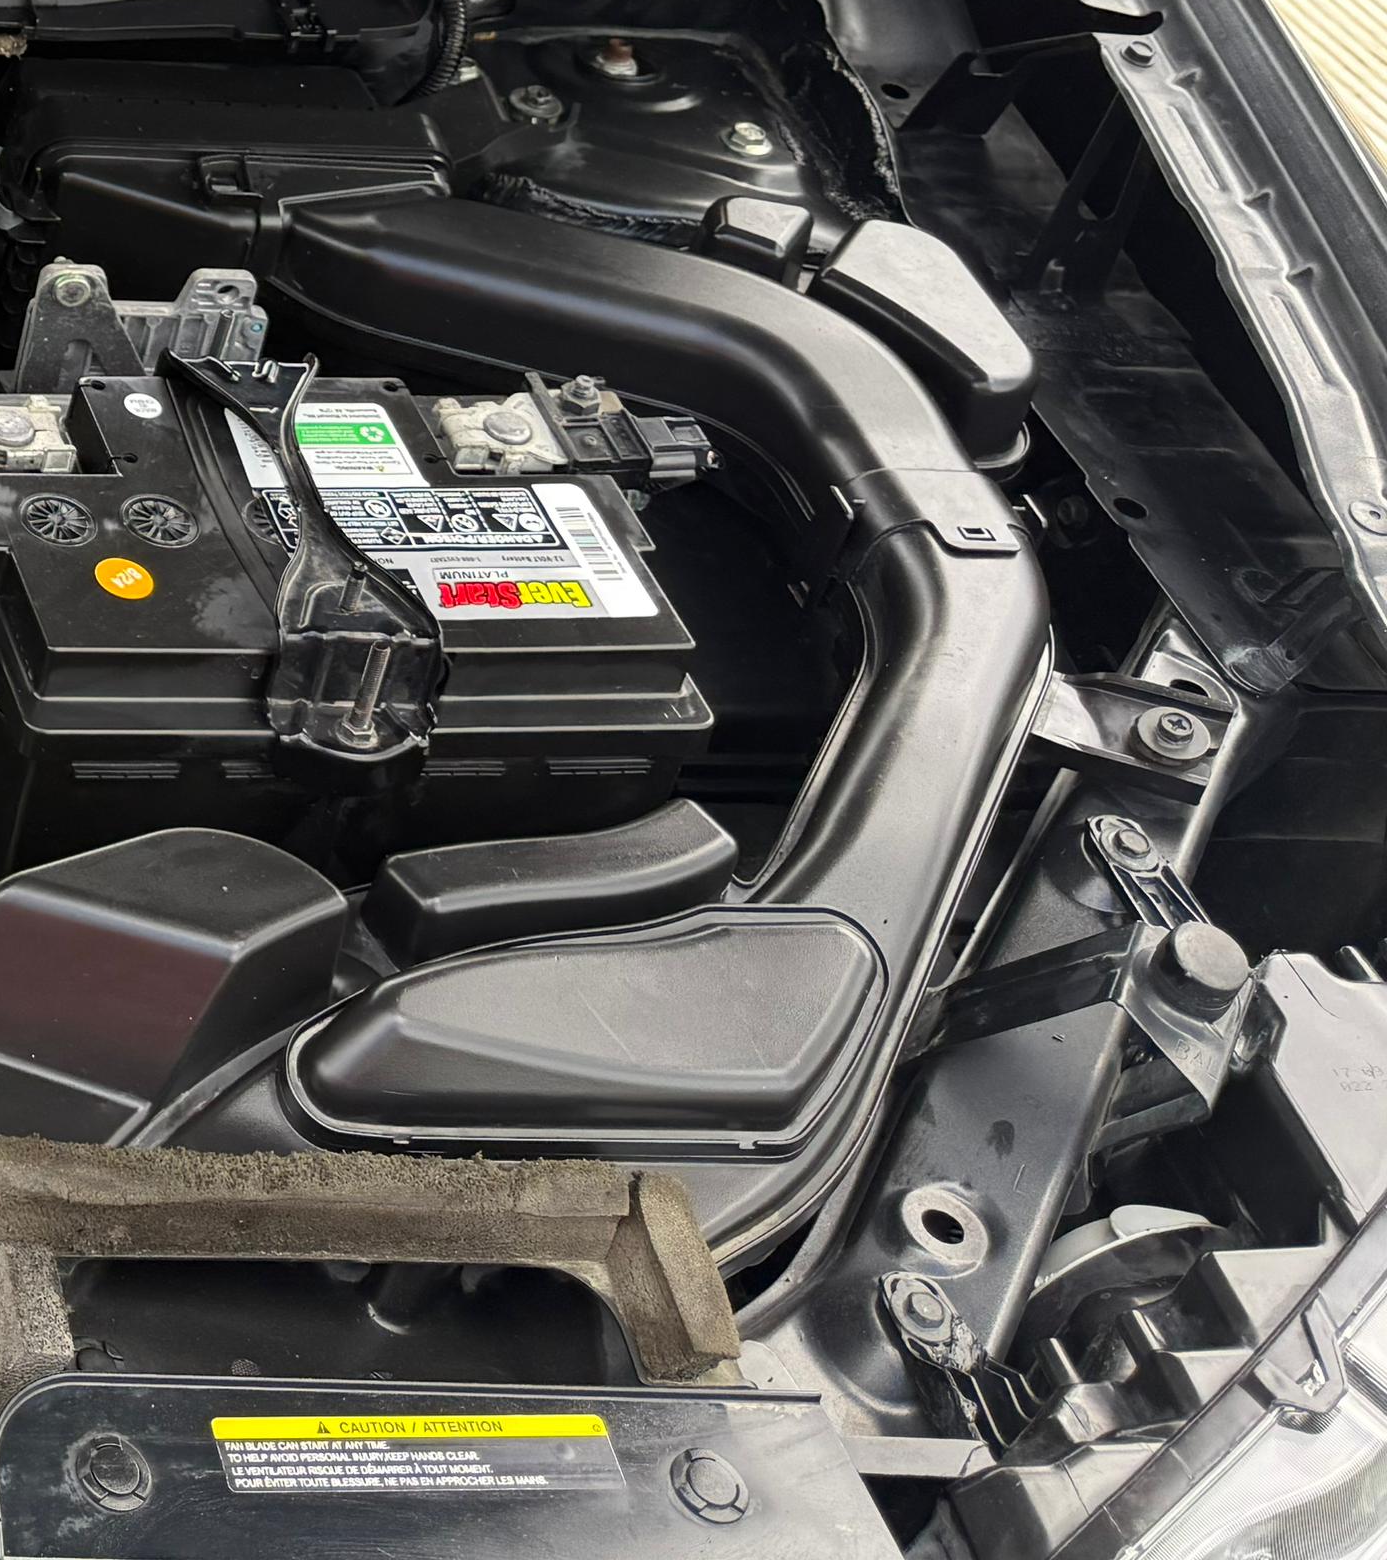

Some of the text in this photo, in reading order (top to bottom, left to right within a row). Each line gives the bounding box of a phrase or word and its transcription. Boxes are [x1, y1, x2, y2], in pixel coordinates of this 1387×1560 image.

[109, 566, 144, 588] 8/24
[439, 571, 509, 580] PLATINUM
[438, 580, 593, 608] EverStart
[339, 1420, 504, 1434] CAUTION / ATTENTION
[224, 1440, 390, 1451] FAN BLADE CAN START AT ANY TIME.
[228, 1453, 242, 1463] TO
[243, 1453, 268, 1463] HELP
[270, 1453, 299, 1462] AVOID
[300, 1452, 352, 1462] PERSONAL
[411, 1451, 445, 1461] HANDS
[445, 1451, 480, 1461] CLEAR.
[231, 1463, 494, 1476] LE VENTILATEUR RISQUE DE DÉMARRER À TOUT MOMENT.
[235, 1475, 549, 1488] POUR ÉVITER TOUTE BLESSURE, NE PAS EN APPROCHER LES MAINS.
